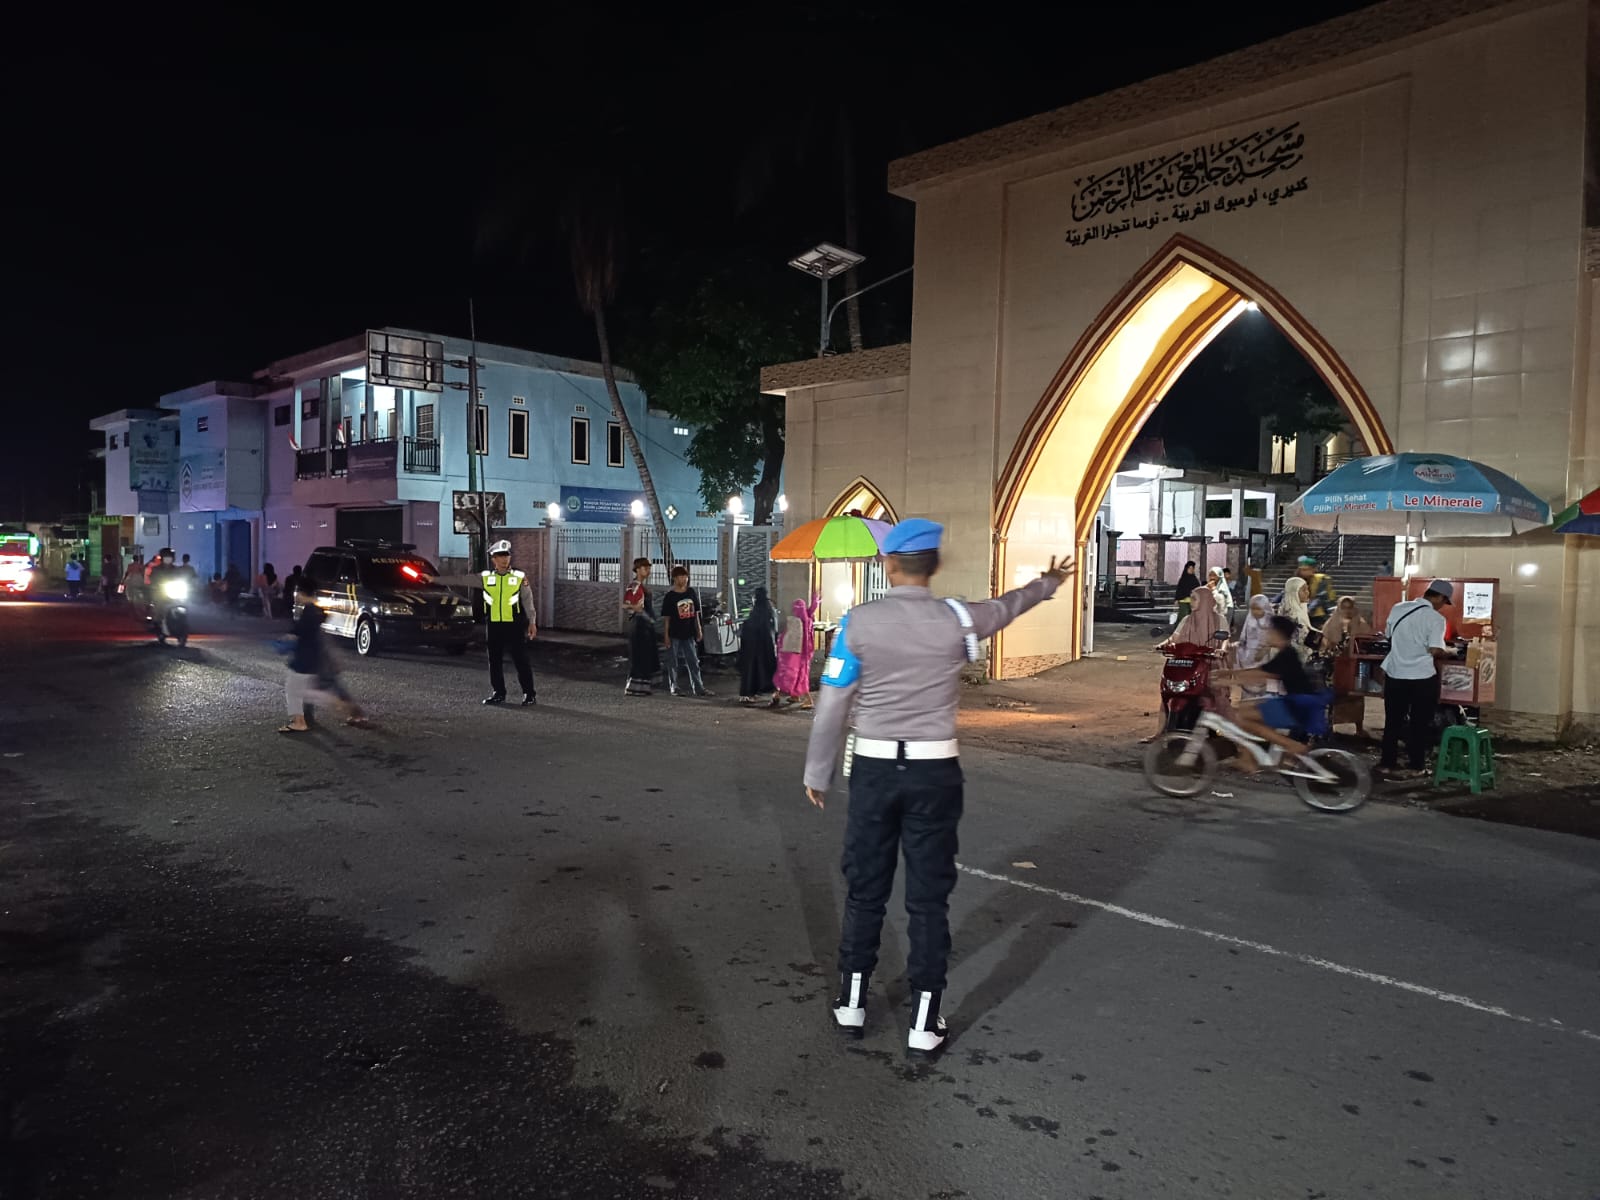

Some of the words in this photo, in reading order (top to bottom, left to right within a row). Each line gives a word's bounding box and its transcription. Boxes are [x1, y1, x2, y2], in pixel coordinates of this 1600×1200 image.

[1325, 495, 1342, 504] Pilih
[1343, 493, 1367, 502] Sehat
[1404, 494, 1419, 507] Le
[1423, 494, 1482, 508] Minerale
[1344, 502, 1377, 511] Minerale
